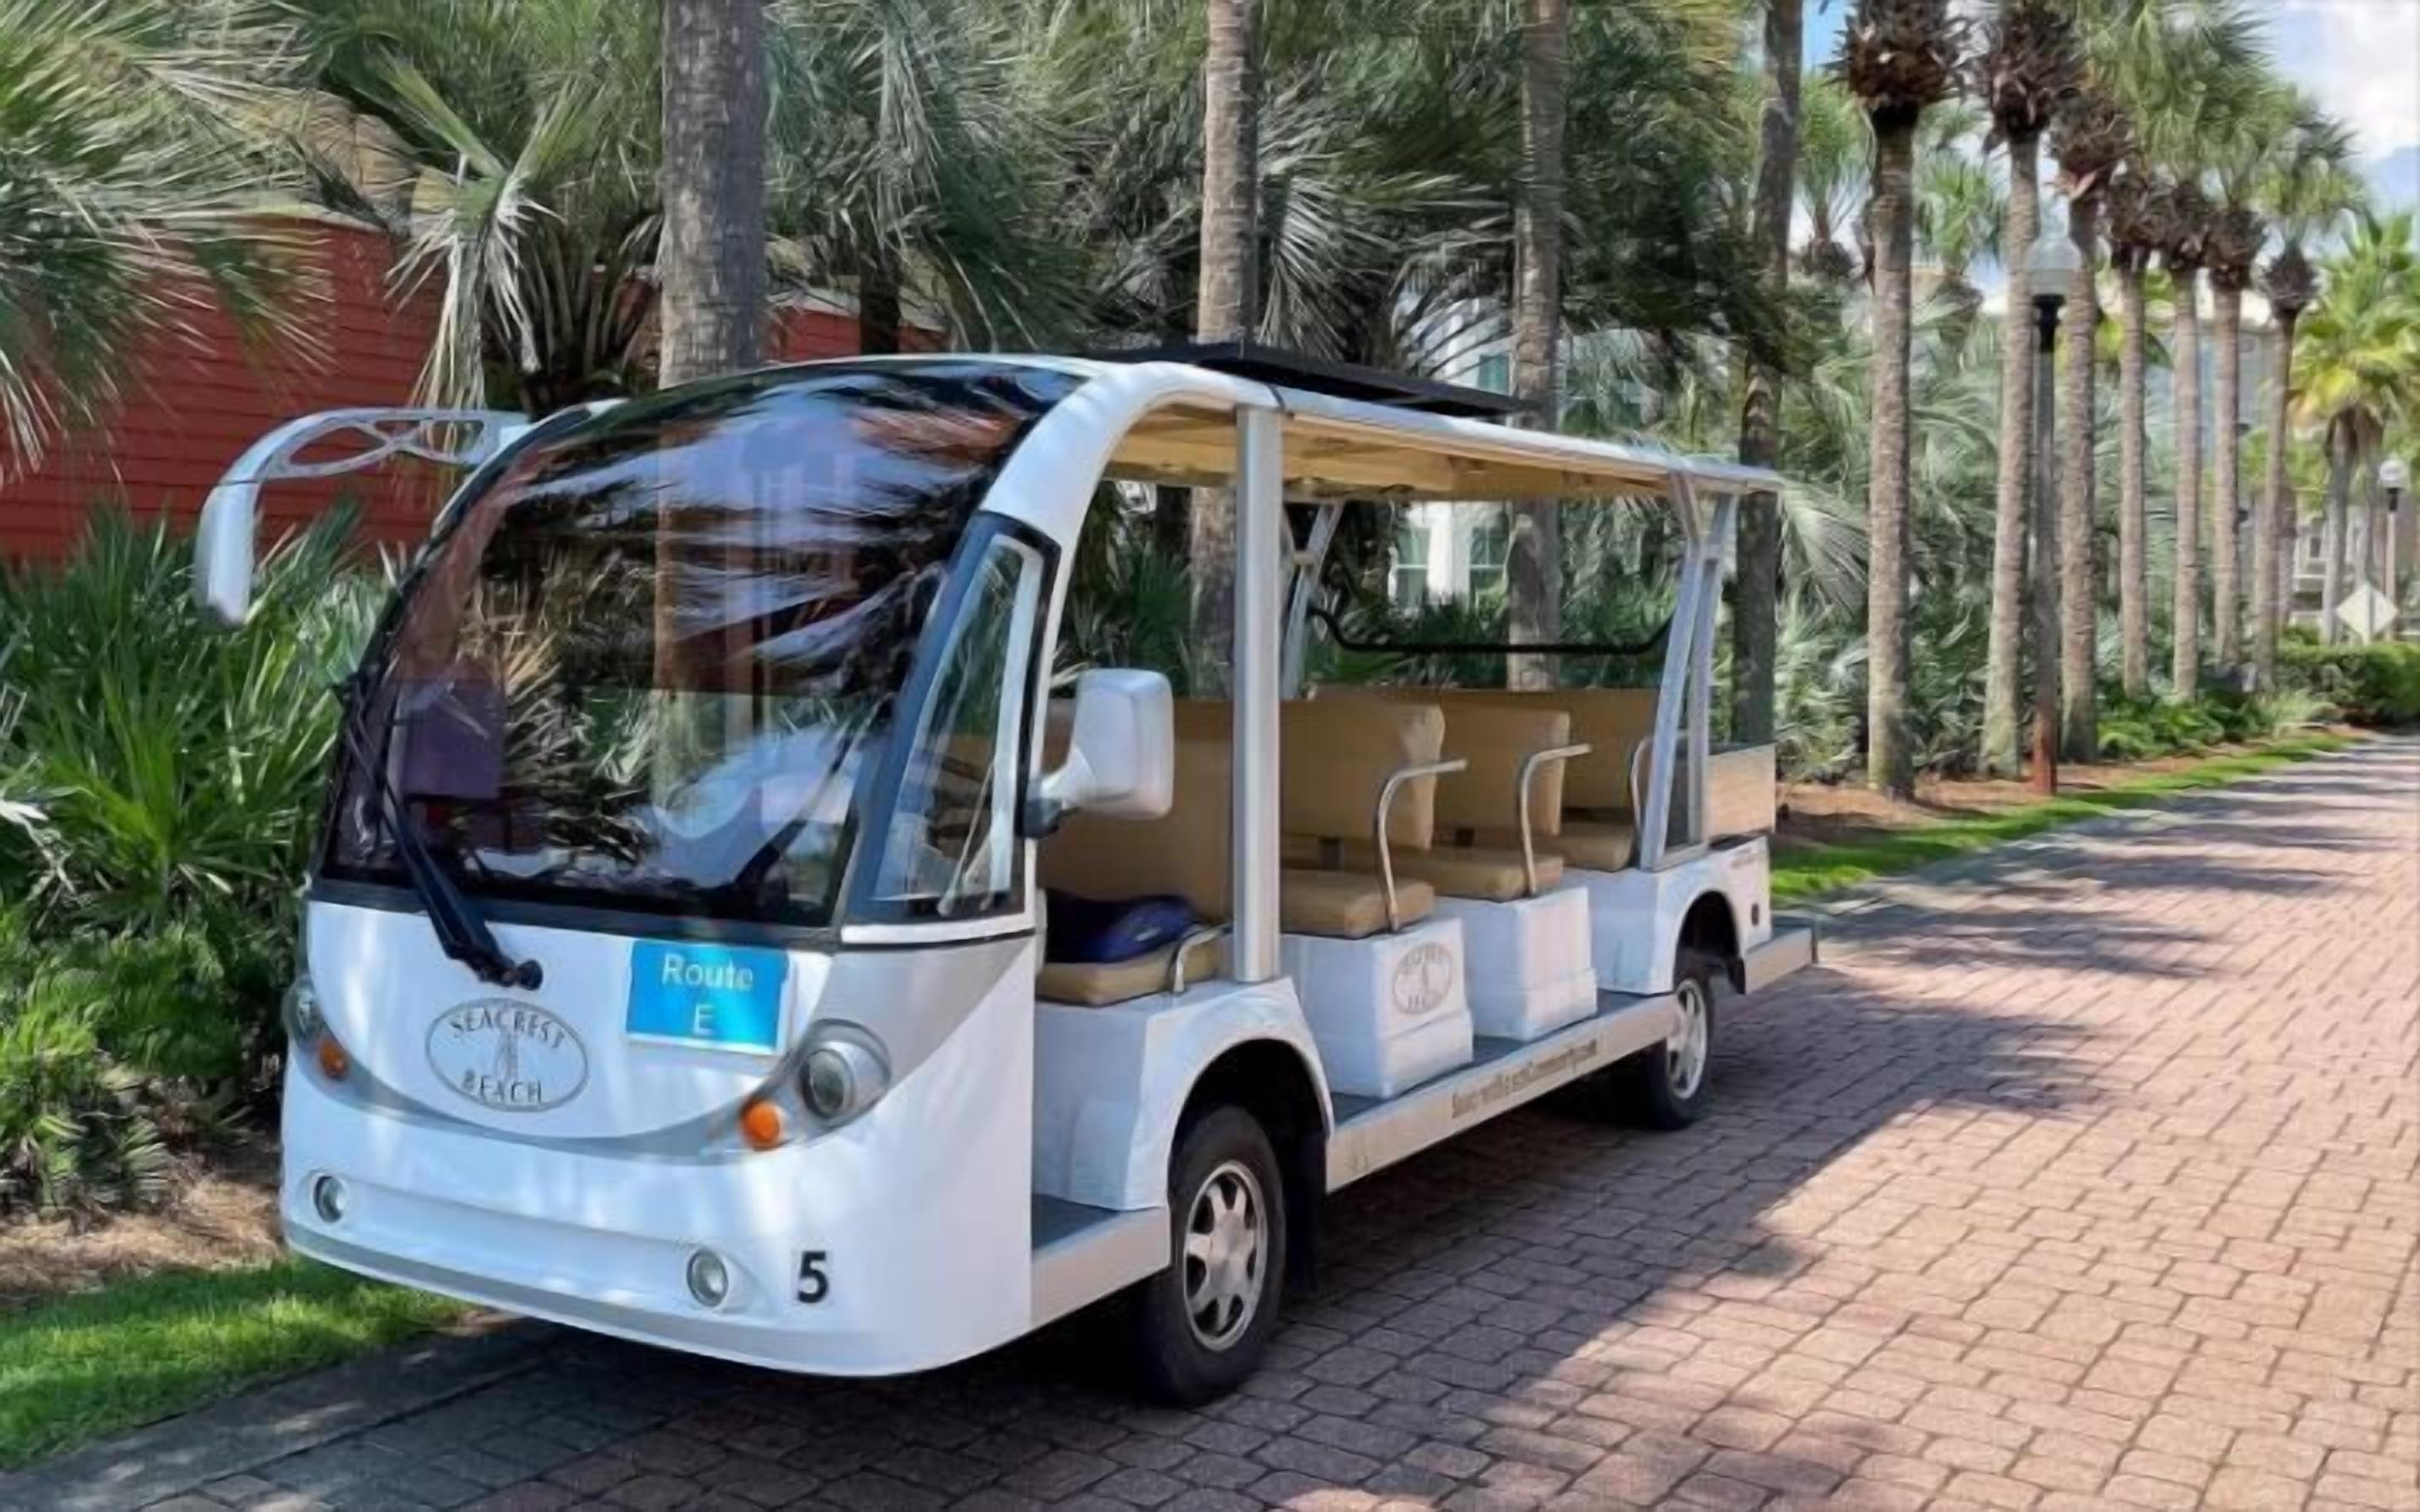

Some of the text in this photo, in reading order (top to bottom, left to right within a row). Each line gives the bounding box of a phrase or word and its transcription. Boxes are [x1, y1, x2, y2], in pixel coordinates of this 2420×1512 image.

[661, 952, 754, 991] Route
[448, 1006, 566, 1049] SEACREST
[692, 1003, 715, 1035] E
[464, 1069, 542, 1103] BEACH
[797, 1249, 829, 1304] 5
